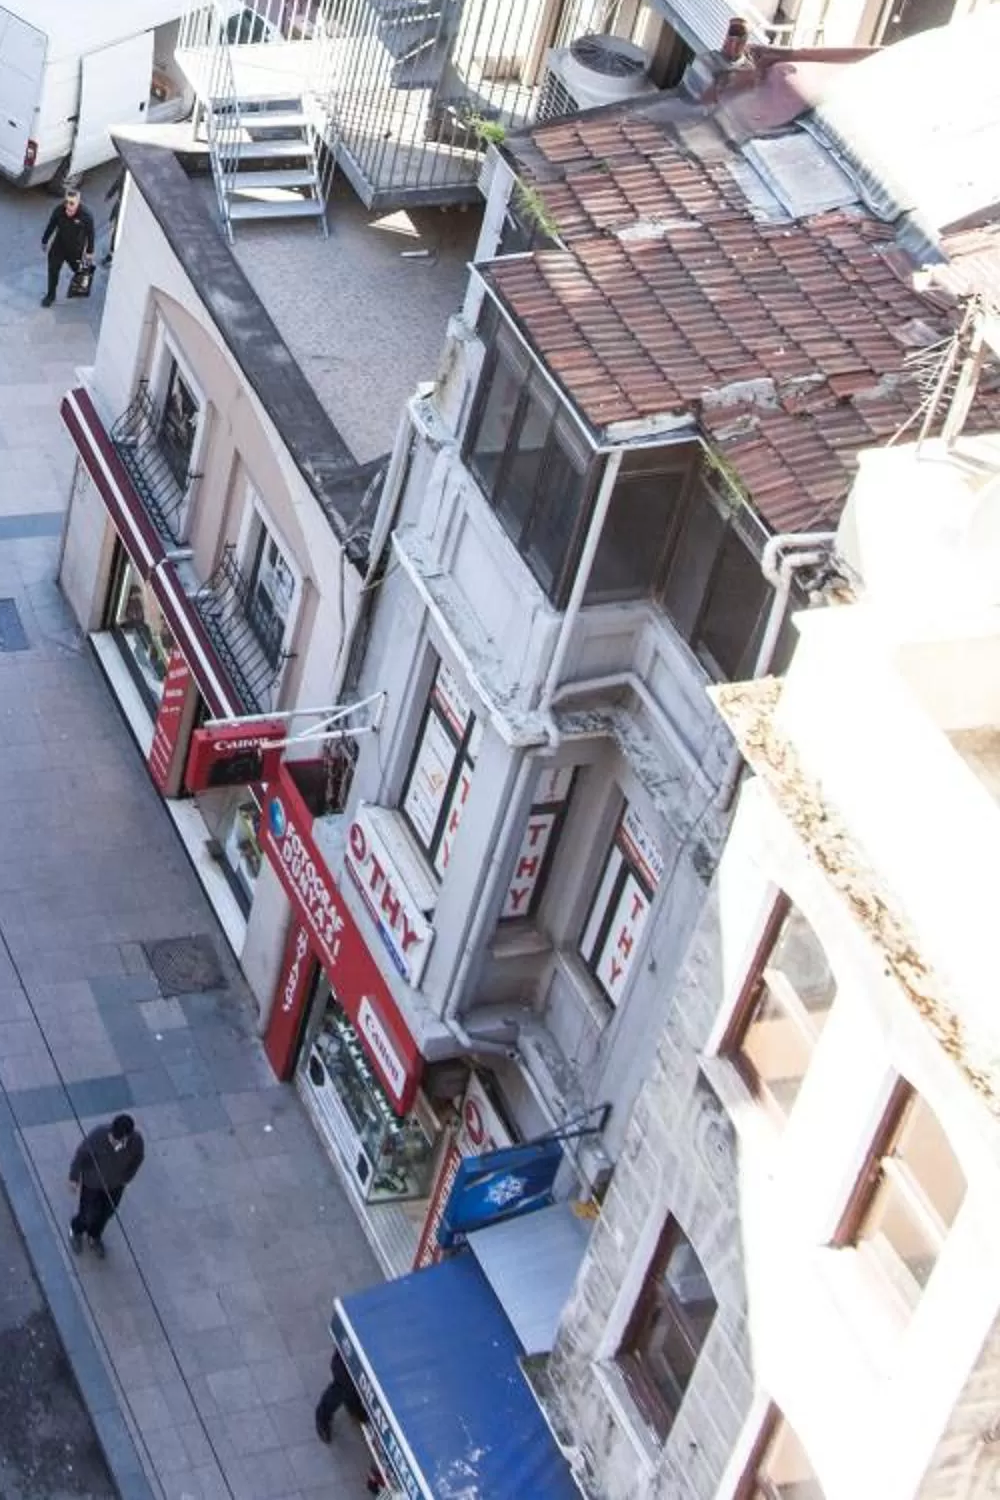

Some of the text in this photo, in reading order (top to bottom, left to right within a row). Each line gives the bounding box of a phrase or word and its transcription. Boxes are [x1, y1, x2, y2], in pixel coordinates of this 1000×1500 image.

[370, 853, 424, 952] THY
[510, 823, 548, 911] THY
[608, 891, 645, 986] THY
